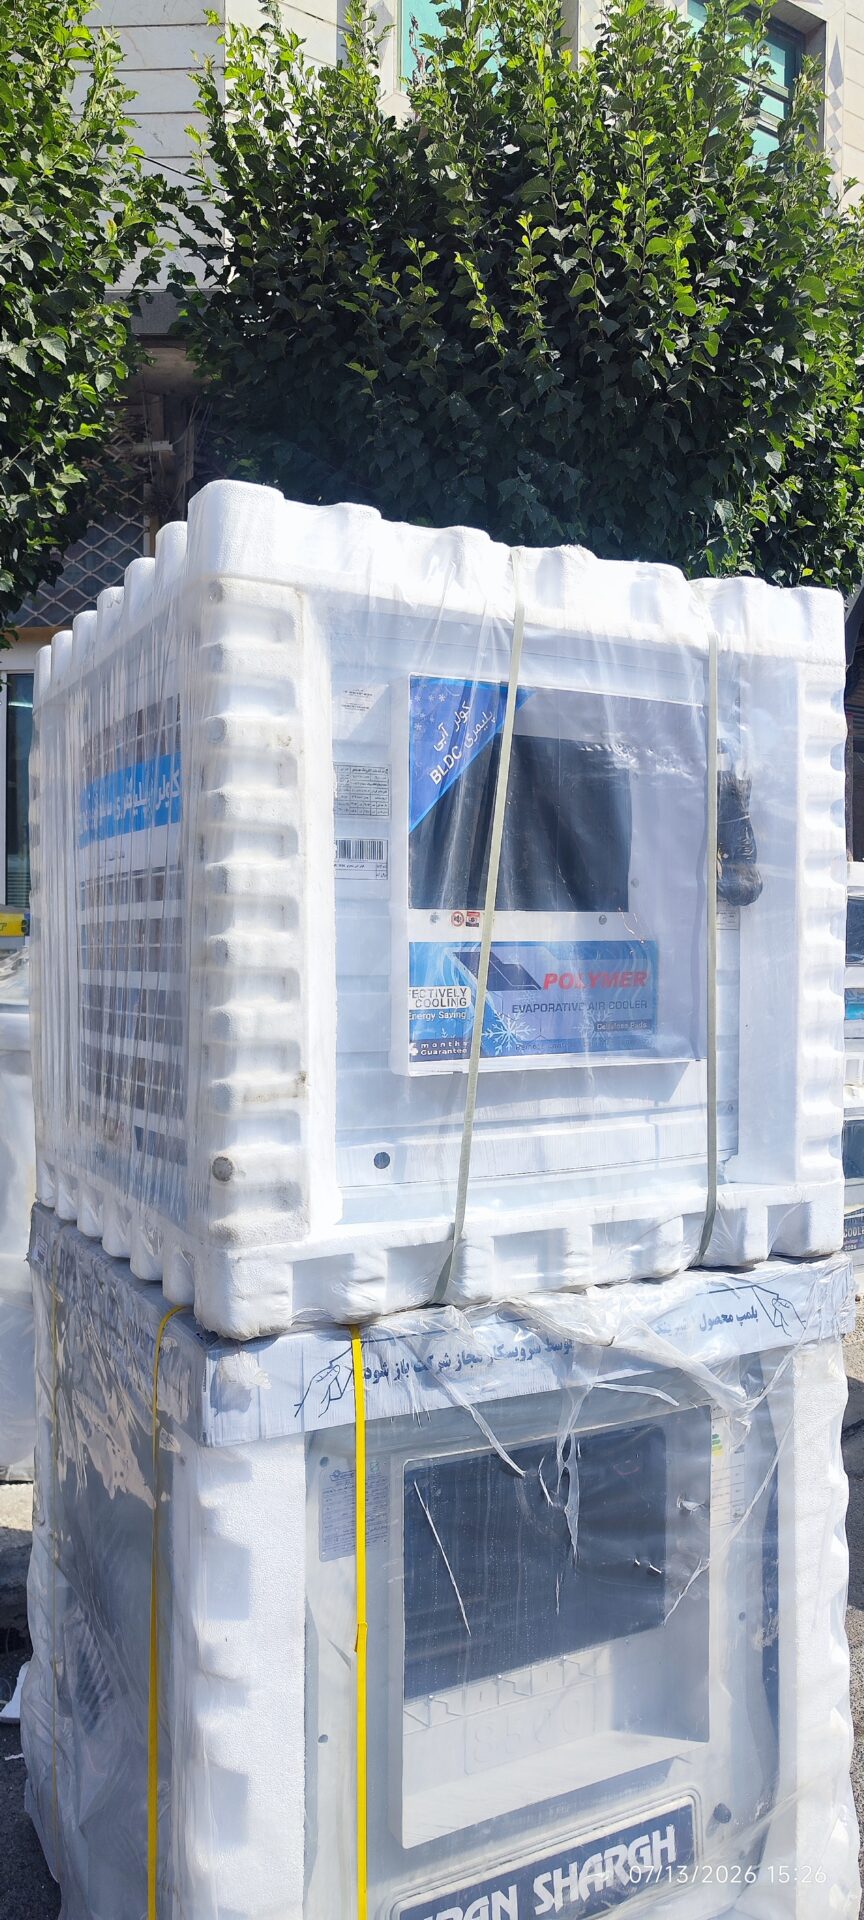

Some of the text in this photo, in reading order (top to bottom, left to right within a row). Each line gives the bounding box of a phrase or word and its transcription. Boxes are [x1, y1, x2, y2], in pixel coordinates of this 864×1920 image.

[433, 701, 472, 752] کولر آبی
[429, 745, 462, 785] BLDC
[543, 970, 648, 991] POLYMER
[409, 988, 467, 999] ECTIVELY
[416, 997, 467, 1008] COOLING
[439, 1011, 466, 1020] Saving
[512, 999, 648, 1014] EVAPORATIVE AIR COOLER
[420, 1048, 468, 1056] Guarantee
[700, 1312, 733, 1332] محصول
[393, 1358, 410, 1381] باز
[455, 1350, 483, 1372] مجاز
[533, 1824, 676, 1915] SHARGH
